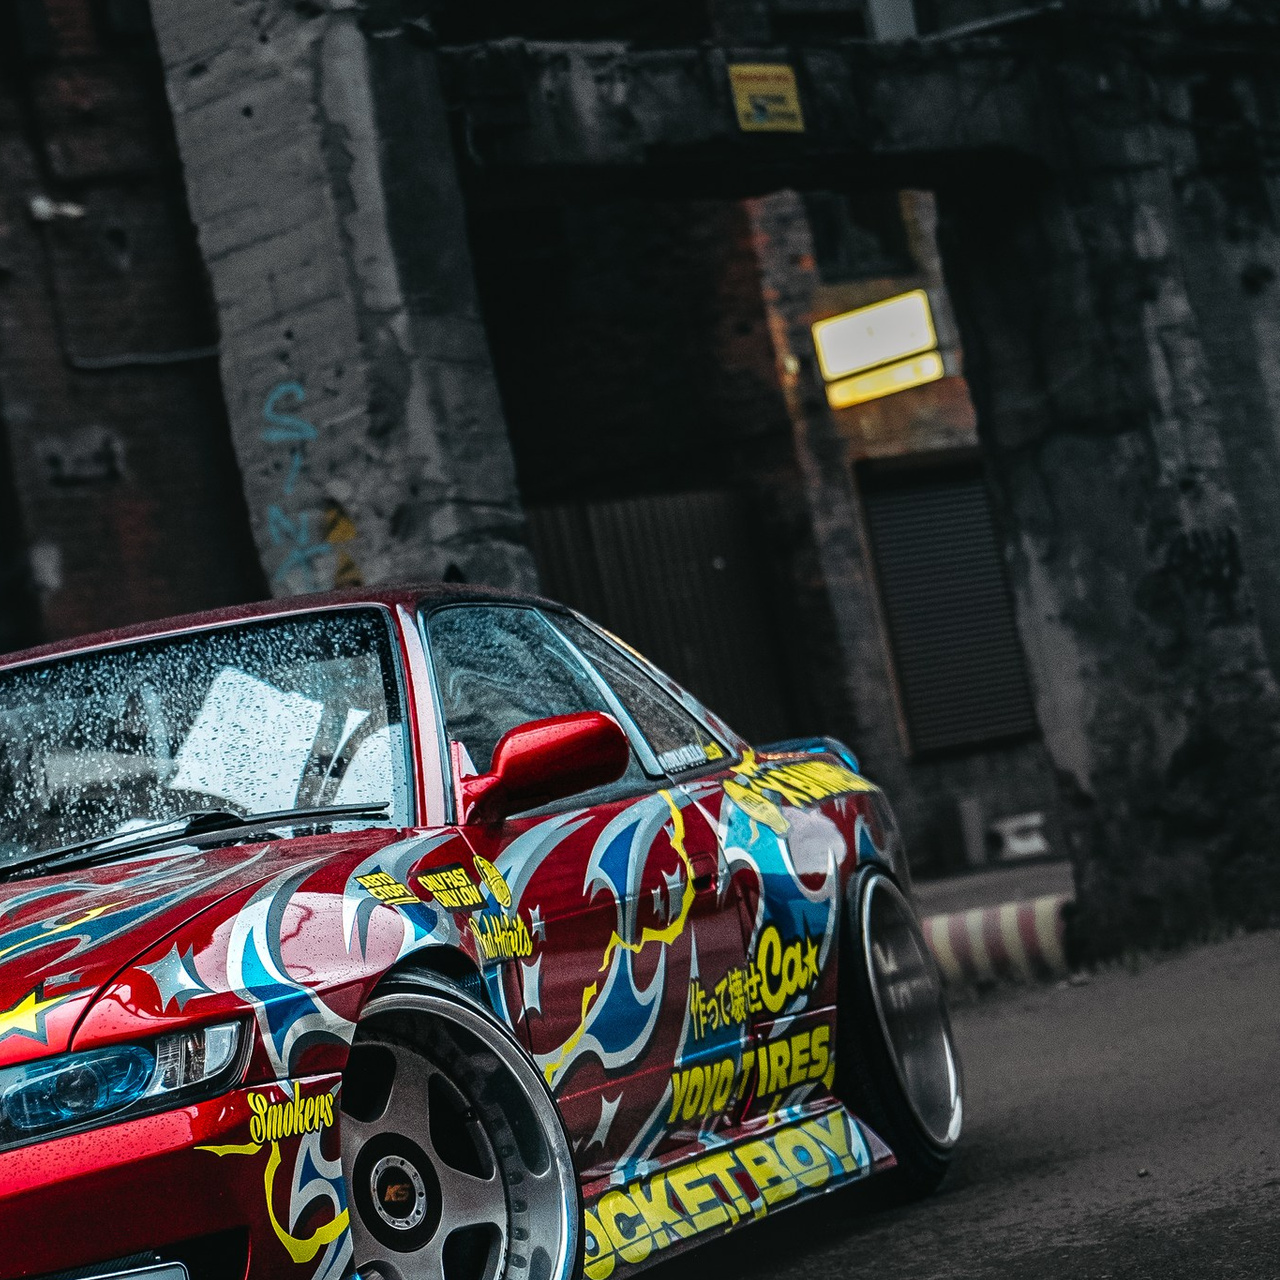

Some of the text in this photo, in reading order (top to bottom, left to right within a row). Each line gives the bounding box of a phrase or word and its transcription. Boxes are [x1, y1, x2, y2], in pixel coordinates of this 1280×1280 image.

[355, 871, 397, 889] АВТО
[417, 867, 473, 892] ONLY FAST
[367, 885, 412, 901] СПОРТ
[432, 884, 484, 908] ONLY LOW
[689, 962, 763, 1041] 作って壊せ
[667, 1025, 830, 1124] YOYO TIRES
[246, 1080, 334, 1144] Smokers
